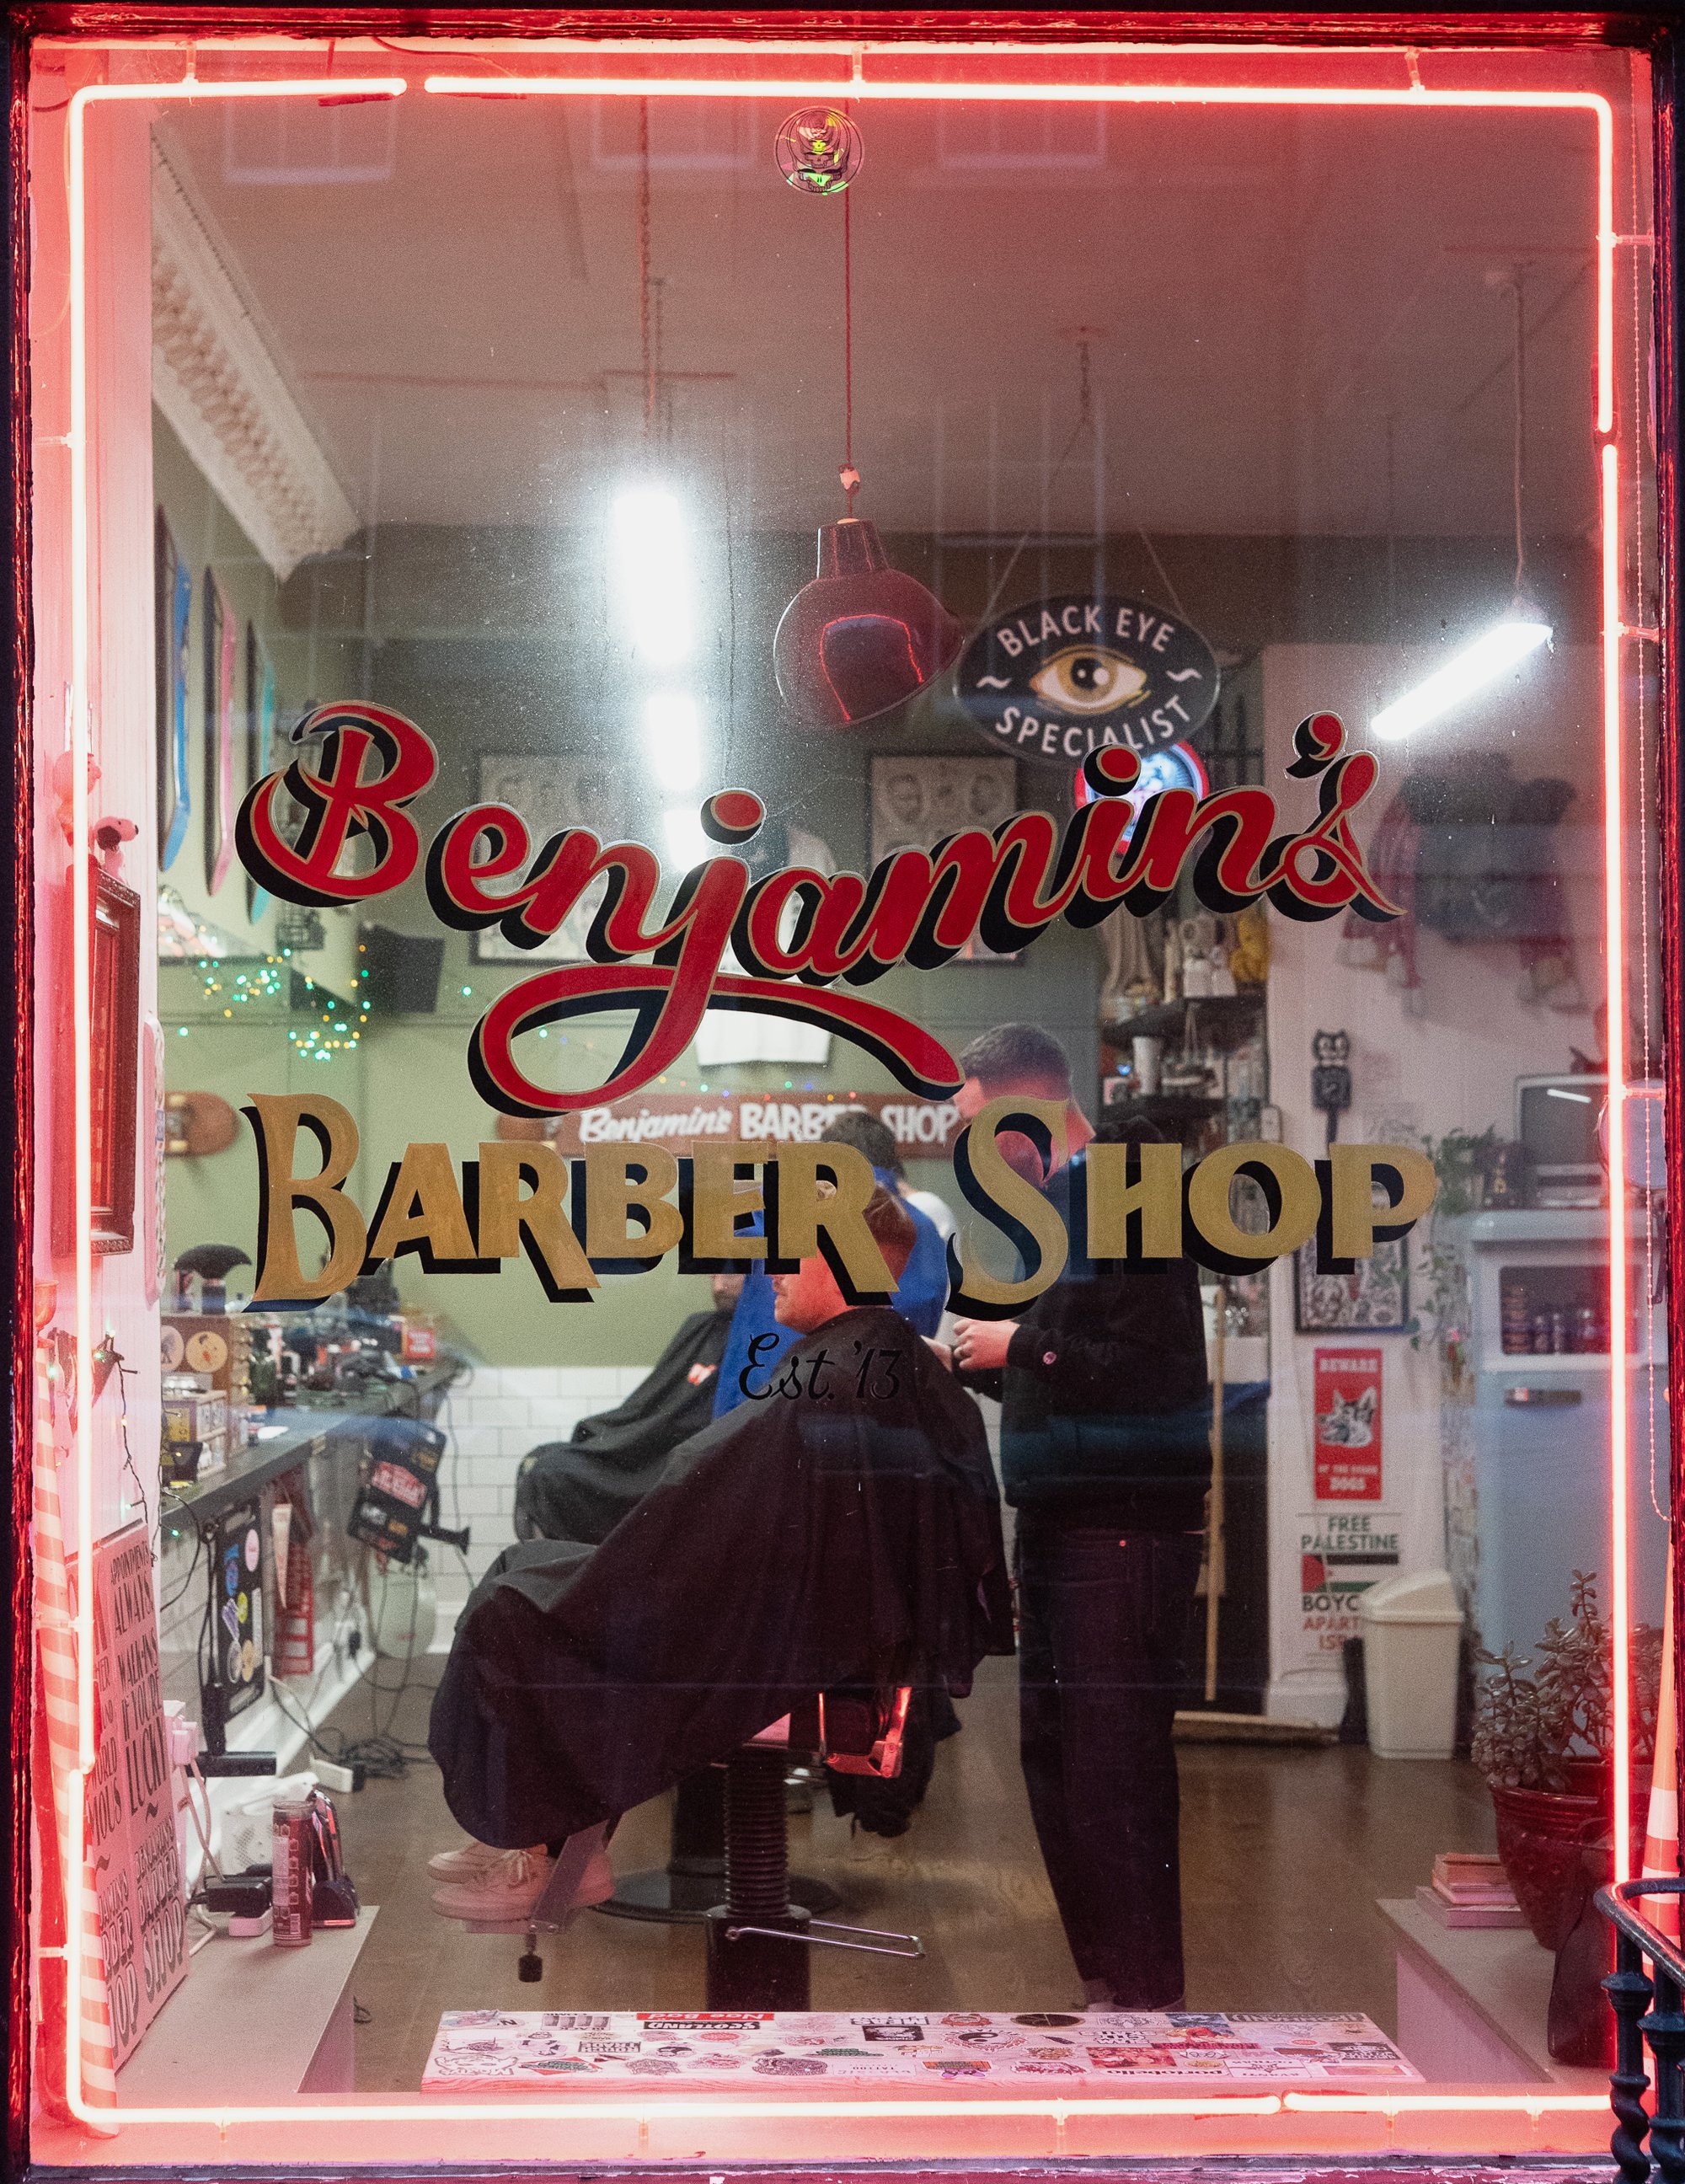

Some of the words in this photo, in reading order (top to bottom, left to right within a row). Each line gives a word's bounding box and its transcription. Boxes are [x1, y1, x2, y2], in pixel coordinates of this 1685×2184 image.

[998, 604, 1102, 656] BLACK
[1116, 607, 1175, 652] EYE
[994, 694, 1190, 757] SPECIALIST
[235, 700, 1406, 1117] Benjamin's
[580, 1106, 733, 1143] Benjamin's
[880, 1105, 961, 1146] SHOP
[240, 1093, 899, 1312] BARBER
[945, 1095, 1438, 1321] SHOP
[738, 1333, 835, 1400] Est.
[1301, 1534, 1399, 1550] PALESTINE
[1327, 1516, 1371, 1532] FREE
[1302, 1595, 1360, 1612] BOYC
[117, 1627, 159, 1692] WALK-INS
[126, 1716, 167, 1817] LUCKY
[136, 1846, 179, 1934] BARBER
[143, 1897, 185, 2003] SHOP
